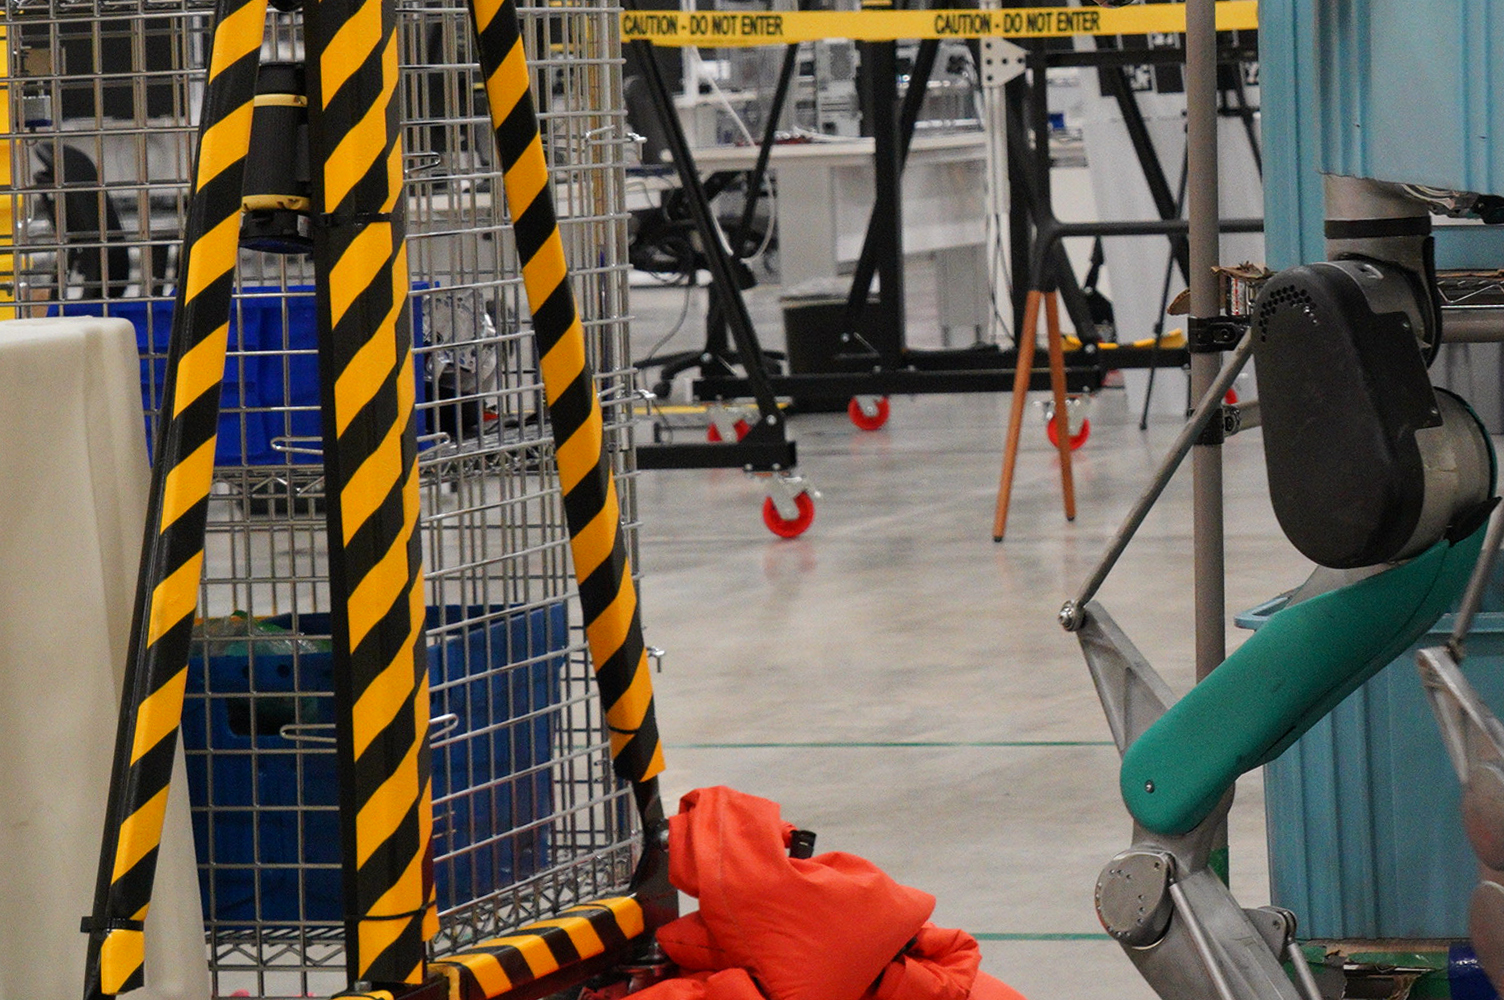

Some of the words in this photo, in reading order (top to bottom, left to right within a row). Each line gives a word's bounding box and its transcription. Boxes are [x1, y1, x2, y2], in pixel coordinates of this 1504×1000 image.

[622, 15, 678, 35] CAUTION
[690, 15, 708, 35] DO
[712, 15, 738, 35] NOT
[741, 16, 783, 36] ENTER
[935, 13, 992, 34] CAUTION
[1003, 13, 1023, 33] DO
[1026, 12, 1053, 33] NOT
[1057, 11, 1100, 32] ENTER
